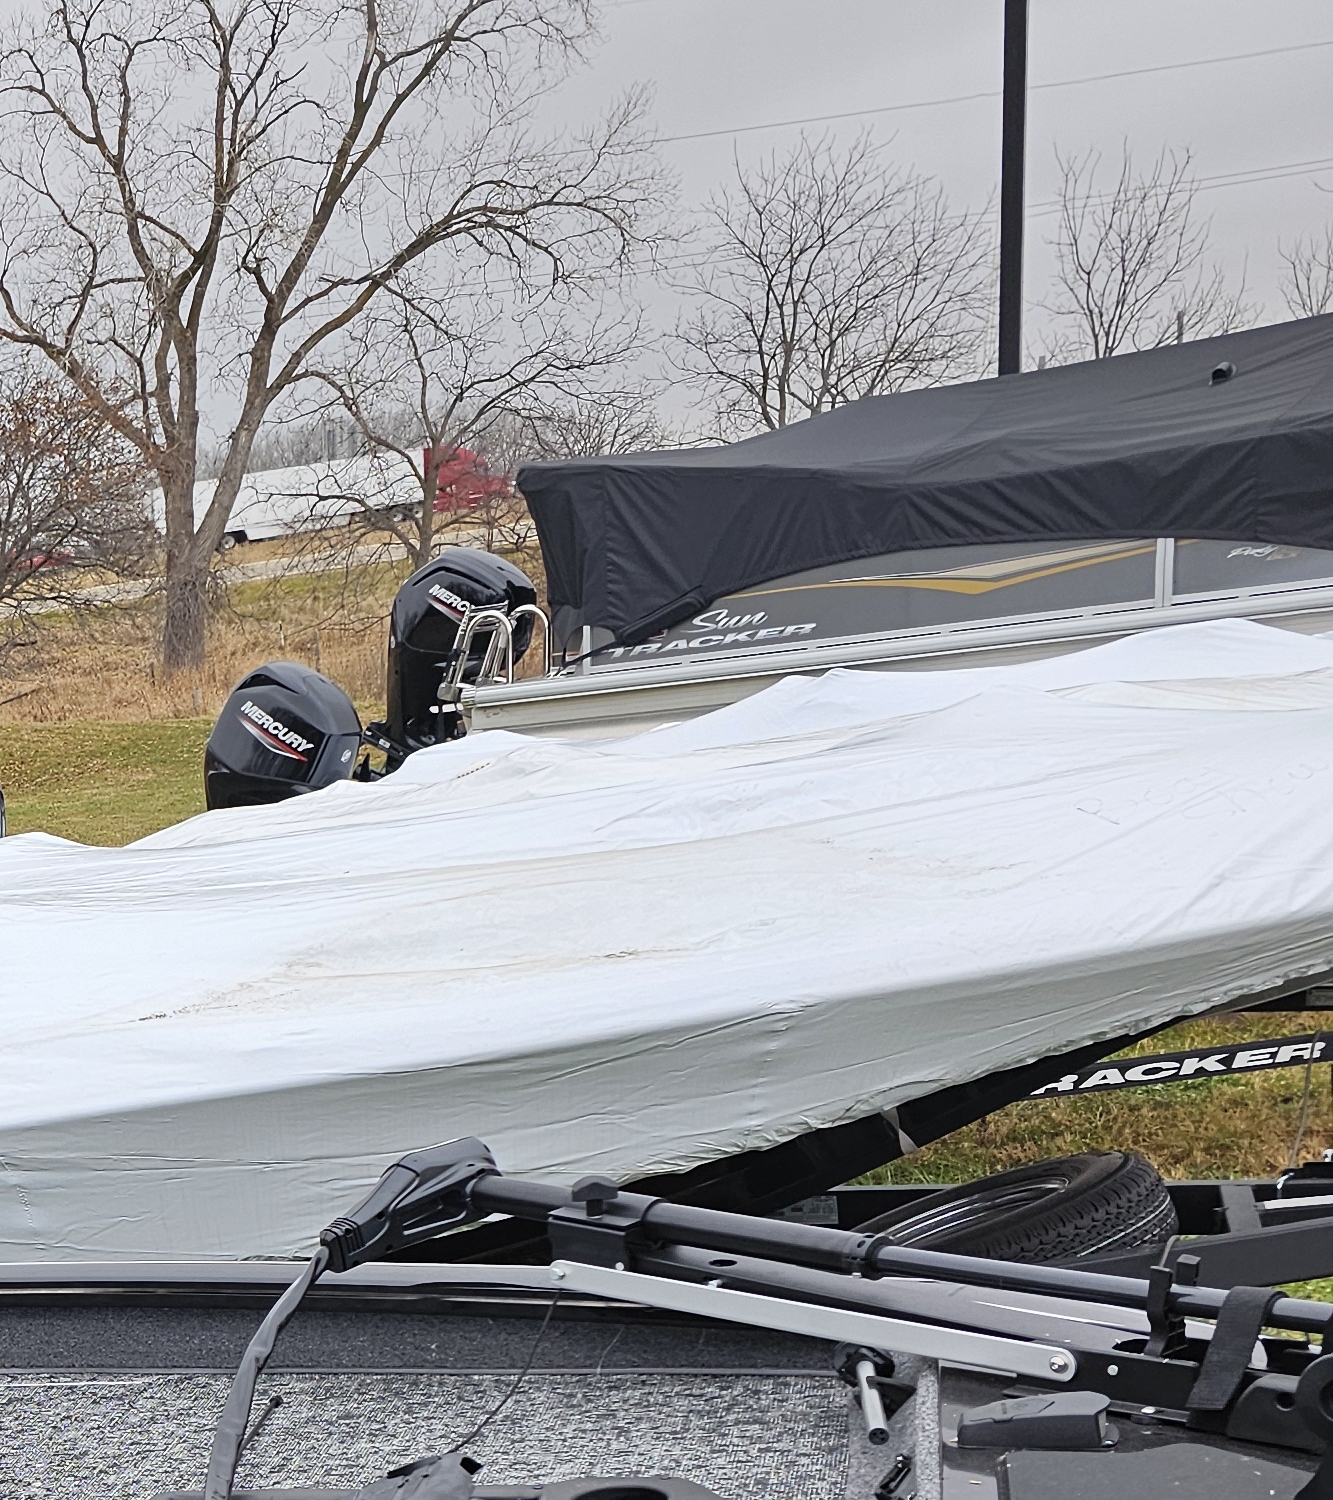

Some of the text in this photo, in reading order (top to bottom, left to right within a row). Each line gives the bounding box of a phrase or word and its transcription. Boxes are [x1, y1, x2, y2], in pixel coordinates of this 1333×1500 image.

[602, 622, 817, 660] TRACKER
[685, 608, 769, 634] Sun
[240, 700, 314, 752] MERCURY
[1029, 1040, 1326, 1096] RACKER
